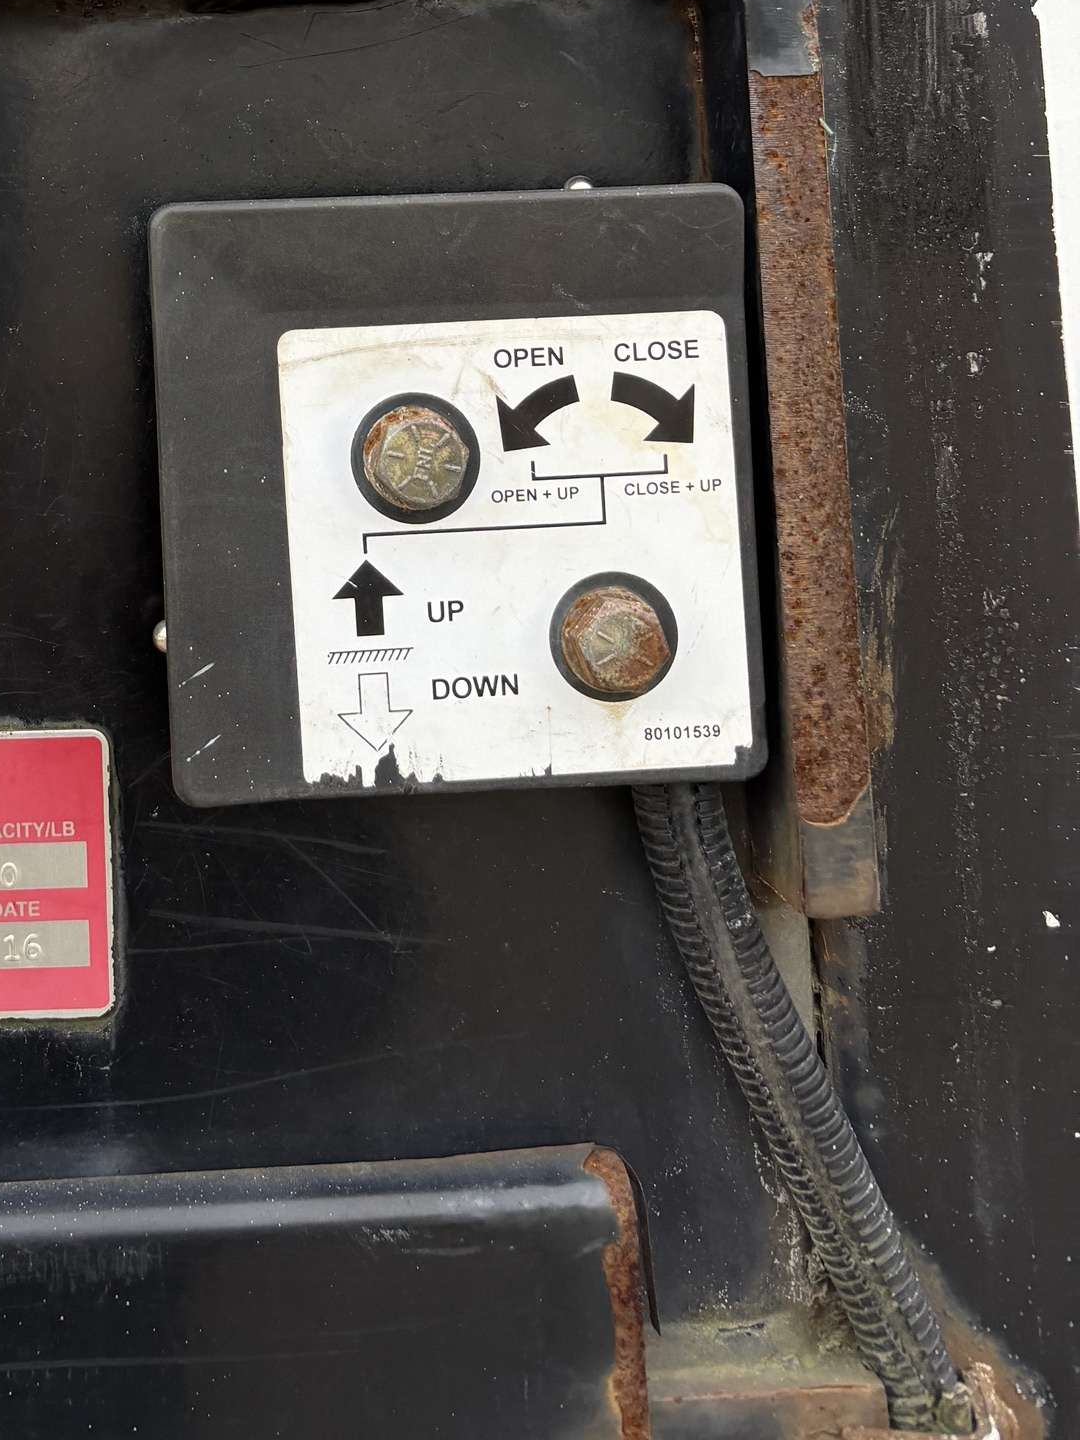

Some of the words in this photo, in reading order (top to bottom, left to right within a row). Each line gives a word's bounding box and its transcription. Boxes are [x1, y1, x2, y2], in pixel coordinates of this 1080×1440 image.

[493, 346, 565, 369] OPEN
[614, 339, 700, 363] CLOSE
[491, 487, 538, 504] OPEN
[557, 486, 579, 501] UP
[624, 481, 682, 497] CLOSE
[700, 478, 722, 493] UP
[427, 600, 465, 624] UP
[431, 673, 519, 700] DOWN
[643, 724, 721, 742] 80101539
